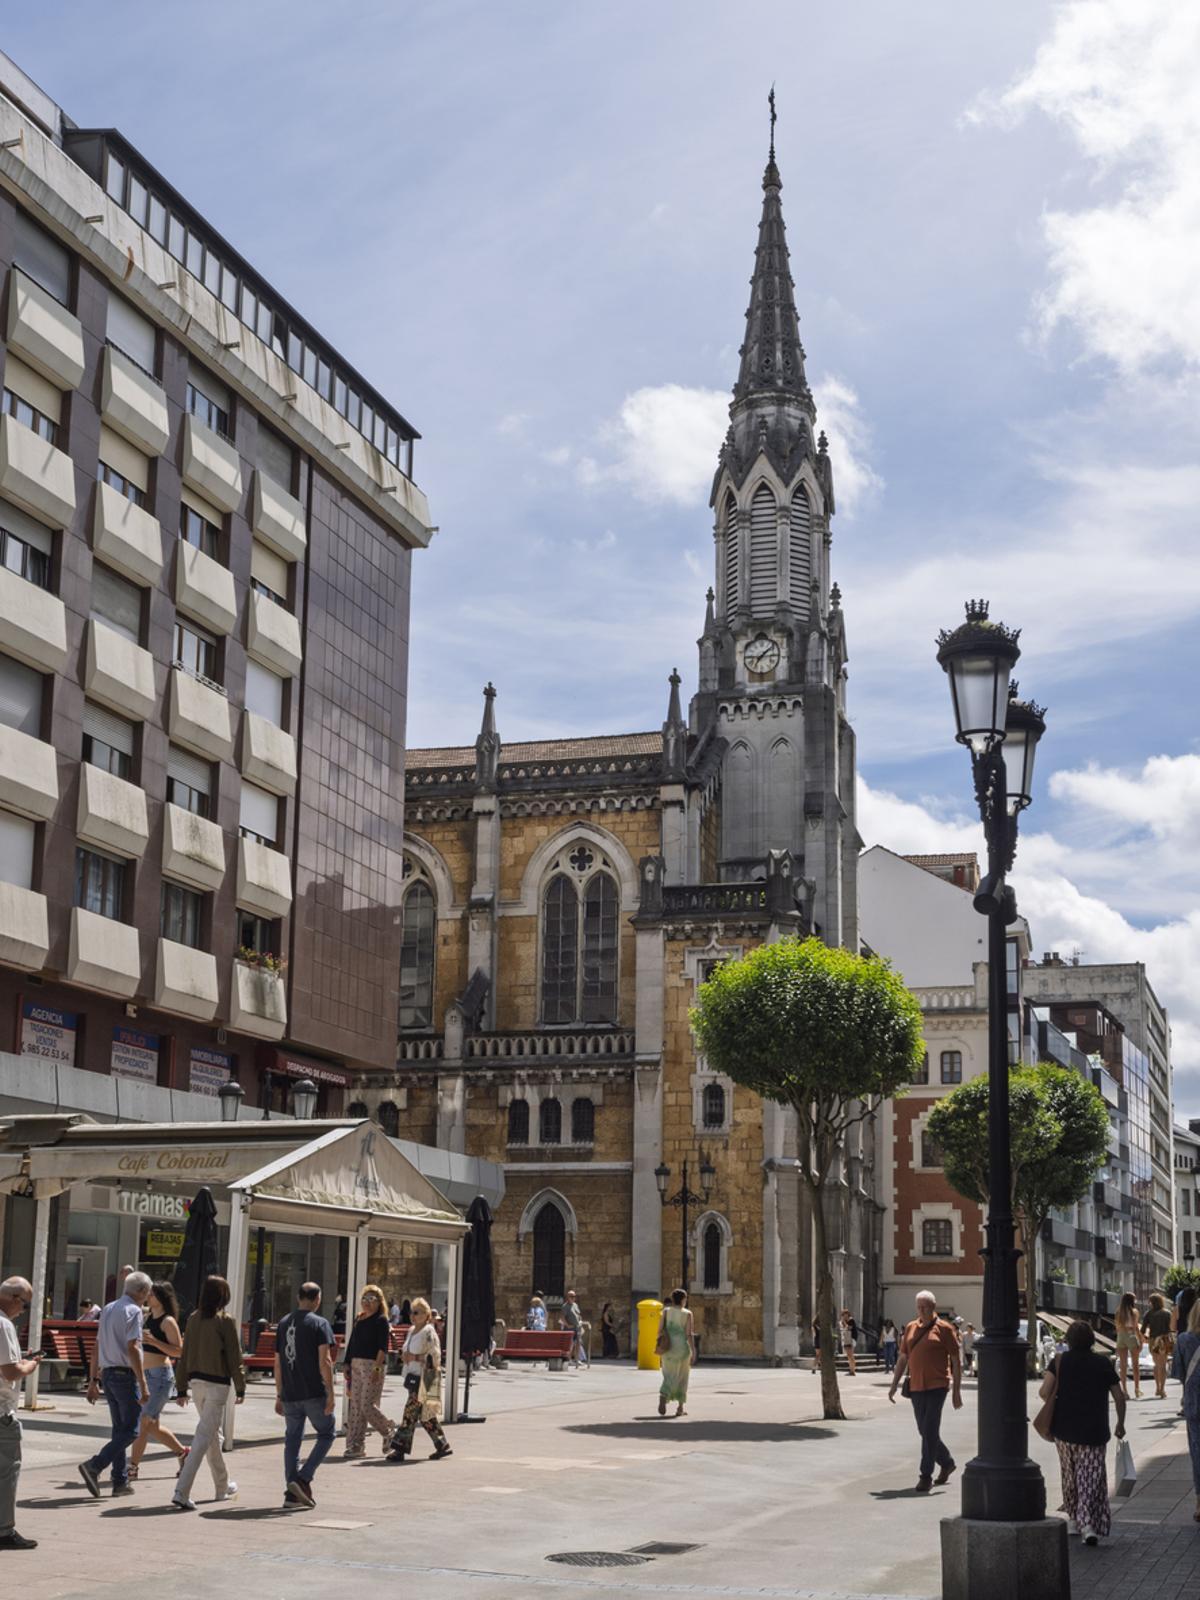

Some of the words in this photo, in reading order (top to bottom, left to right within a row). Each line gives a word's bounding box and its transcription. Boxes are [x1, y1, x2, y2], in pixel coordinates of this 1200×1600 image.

[31, 1008, 63, 1025] AGENCIA
[41, 1046, 51, 1057] 22
[51, 1048, 60, 1059] 53
[118, 1151, 150, 1175] Café
[157, 1151, 230, 1170] Colonial
[120, 1190, 184, 1218] Tramas
[151, 1233, 182, 1246] REBAJAS
